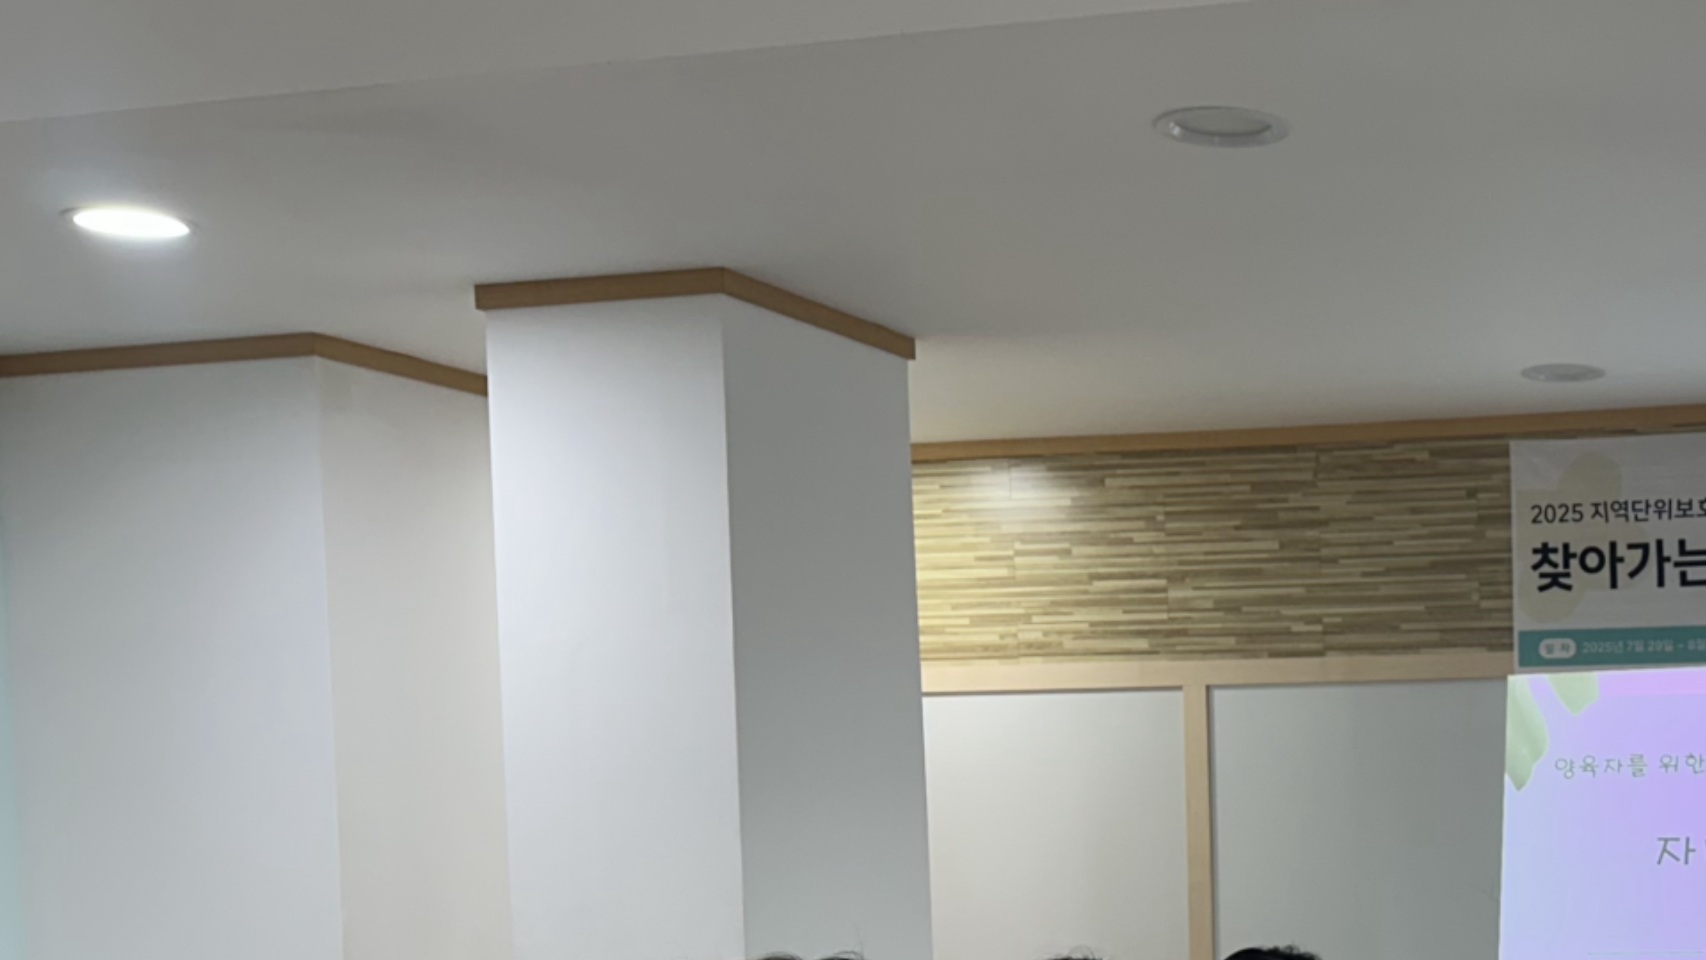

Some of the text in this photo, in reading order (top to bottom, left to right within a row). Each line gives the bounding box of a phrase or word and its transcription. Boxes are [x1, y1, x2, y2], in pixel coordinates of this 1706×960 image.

[1531, 504, 1584, 525] 2025
[1554, 752, 1706, 780] 양육자를 위한
